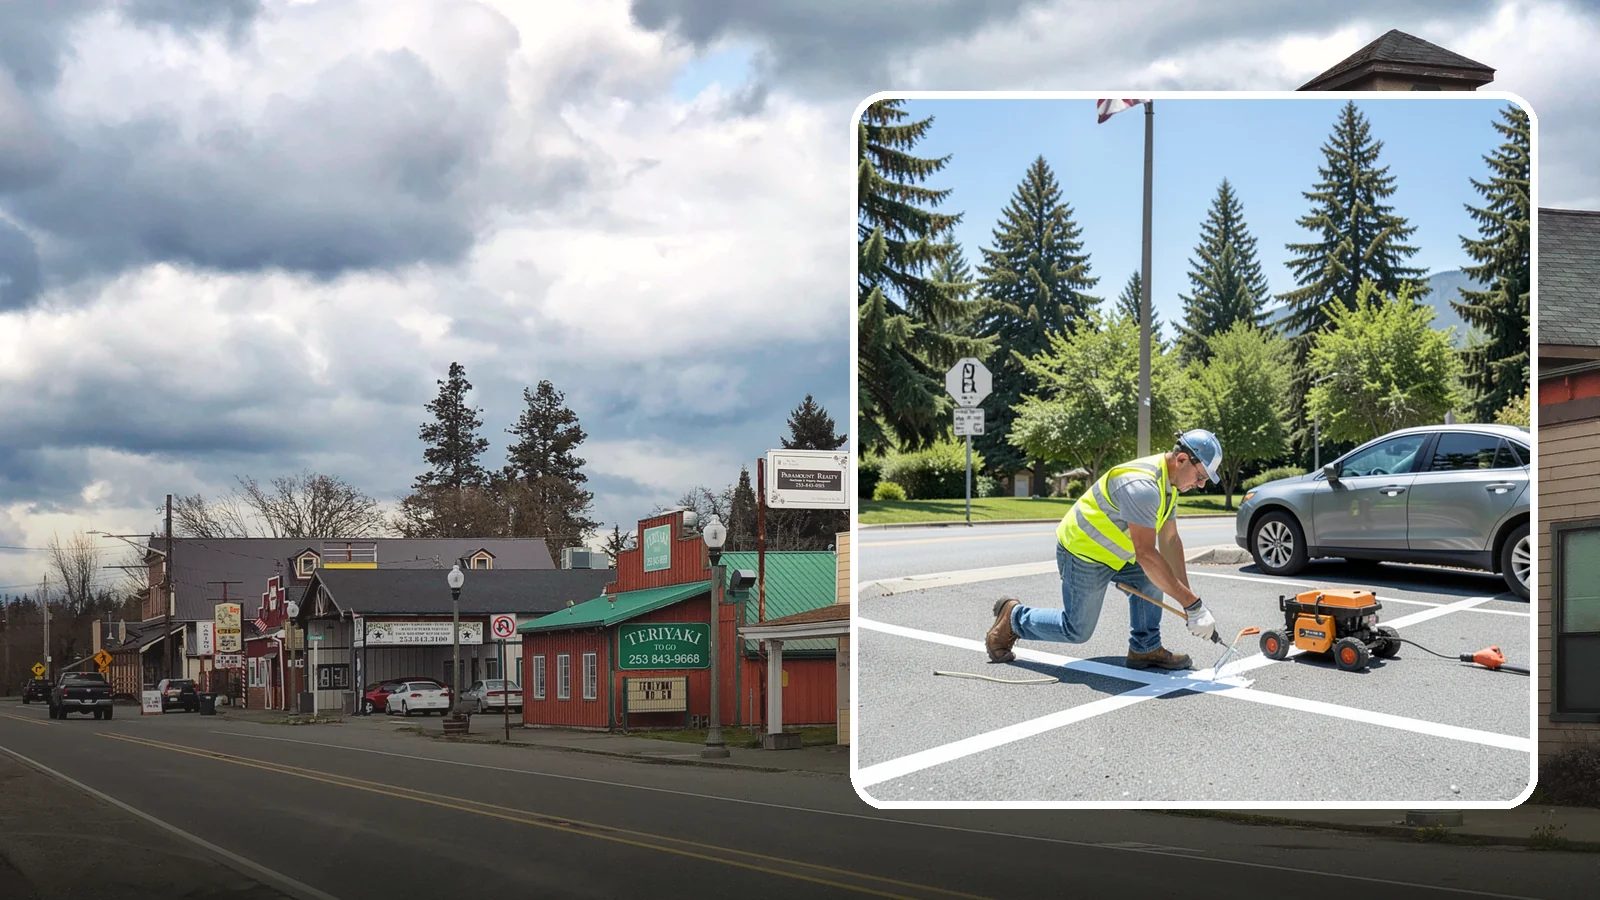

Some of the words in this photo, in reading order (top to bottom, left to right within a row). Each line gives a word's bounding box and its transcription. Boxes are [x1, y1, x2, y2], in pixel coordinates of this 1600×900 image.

[781, 471, 815, 479] PARAMOUNT
[817, 472, 838, 480] REALTY
[646, 531, 669, 548] TERIYAKI
[625, 627, 702, 646] TERIYAKI
[629, 654, 648, 664] 253
[651, 653, 700, 664] 843-9668
